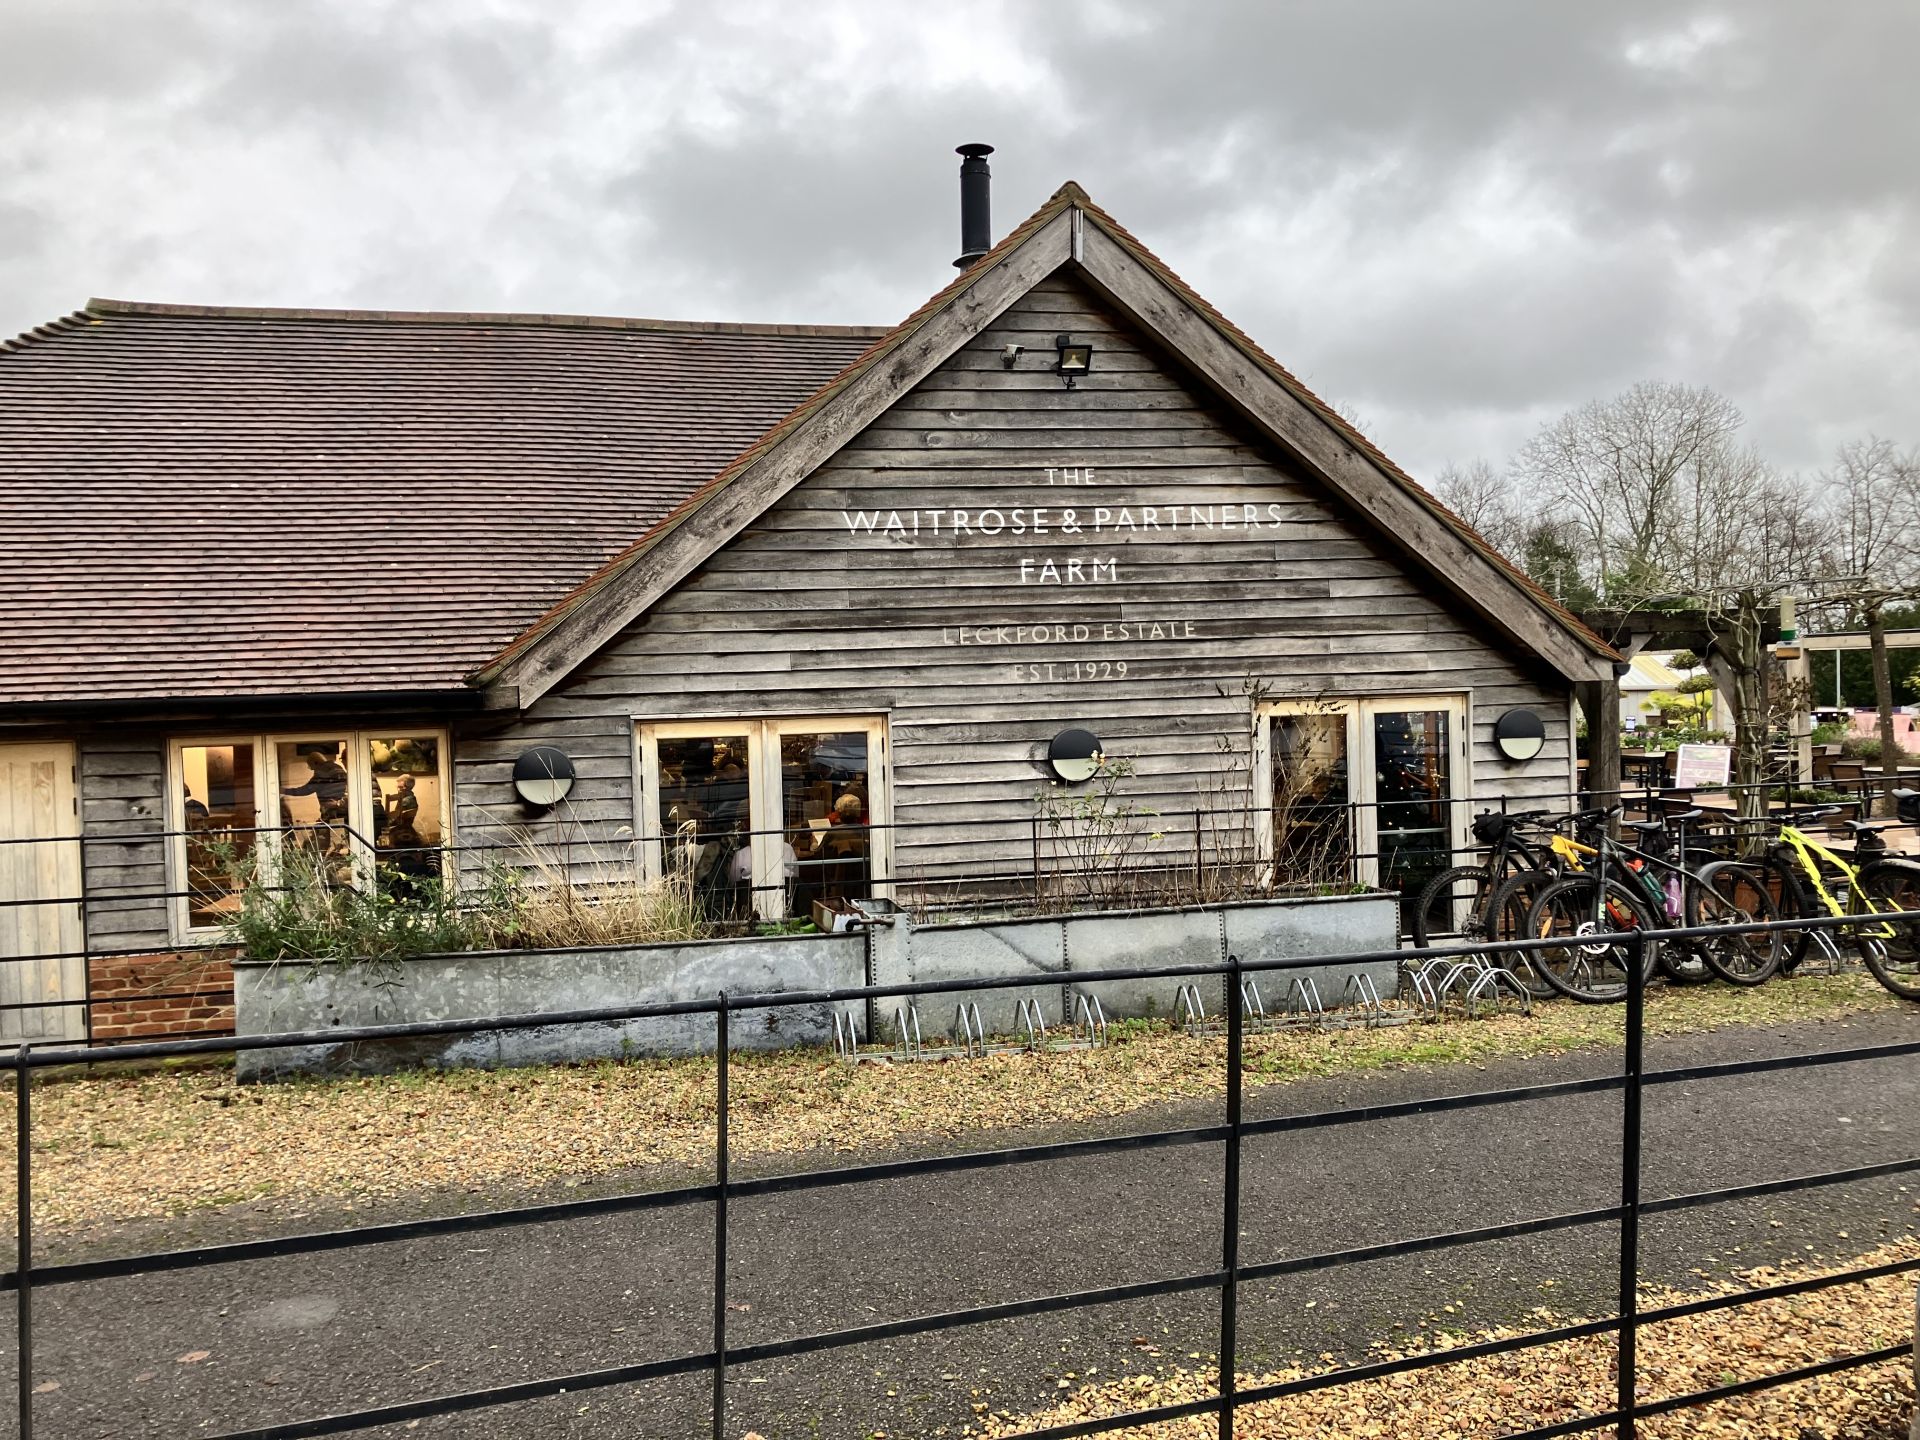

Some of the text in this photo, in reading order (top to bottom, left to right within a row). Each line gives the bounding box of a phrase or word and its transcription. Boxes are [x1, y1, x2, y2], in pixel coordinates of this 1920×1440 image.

[1044, 468, 1096, 486] THE
[842, 504, 1283, 536] WAITROSE & PARTNERS
[1020, 557, 1117, 584] FARM
[943, 621, 1197, 645] LECKFORD ESTATE
[1014, 661, 1128, 681] EST. 1929
